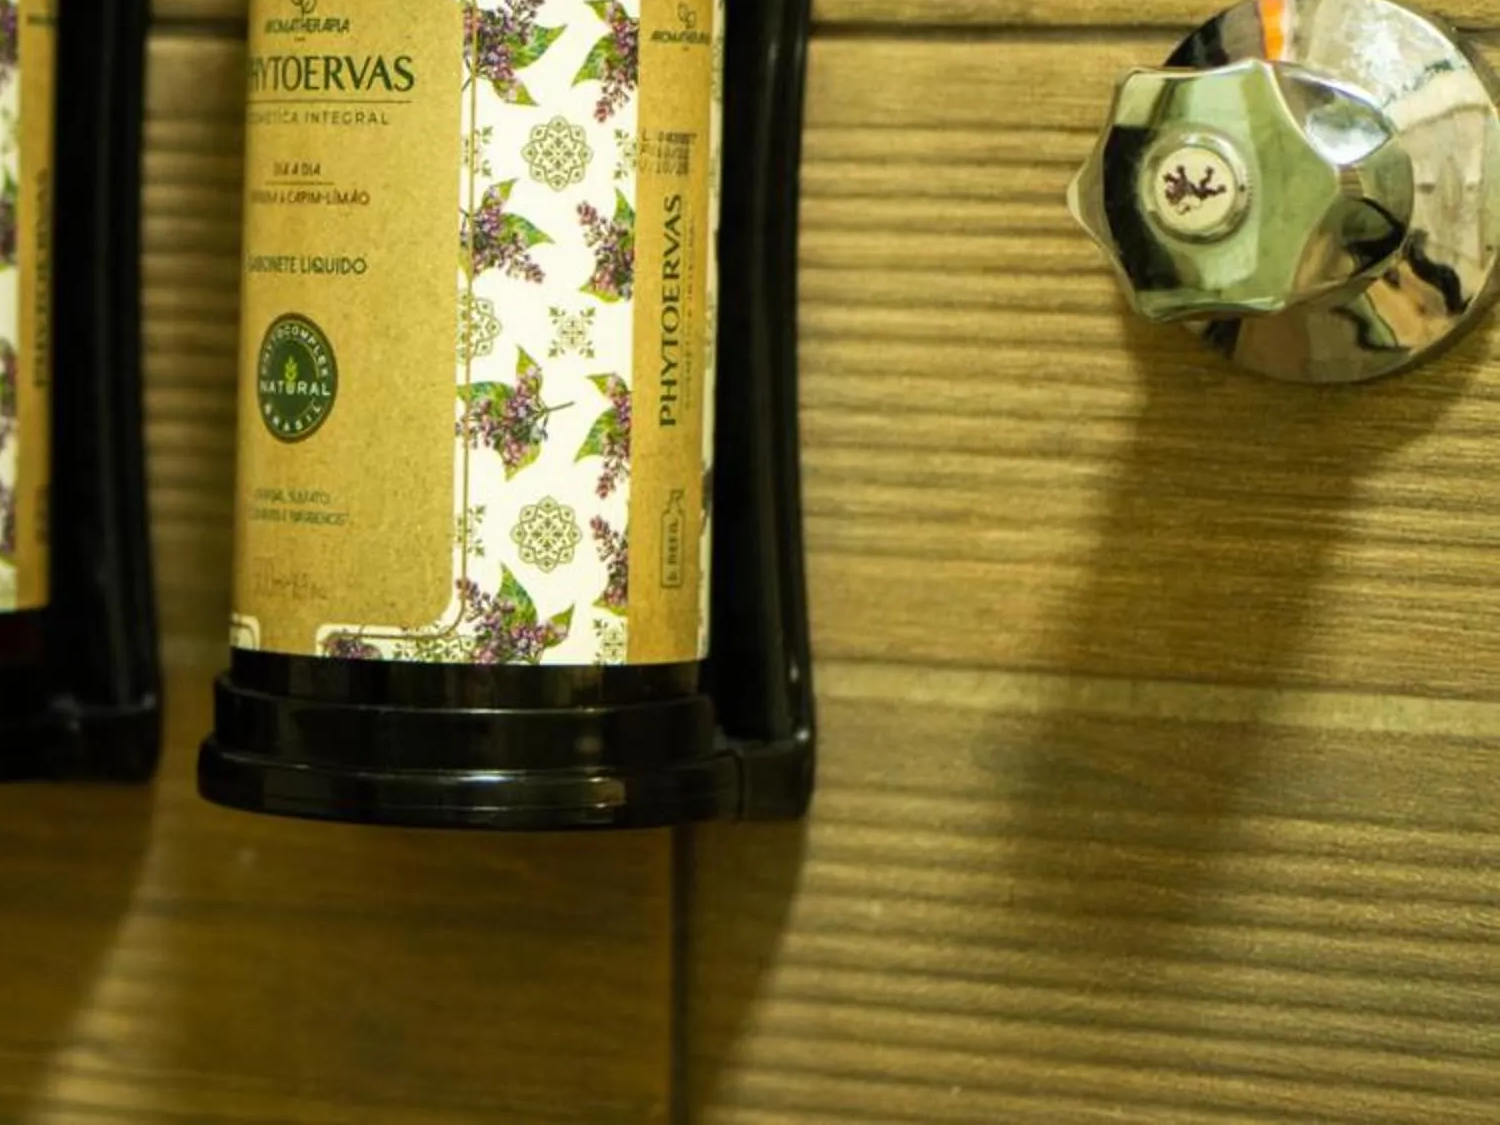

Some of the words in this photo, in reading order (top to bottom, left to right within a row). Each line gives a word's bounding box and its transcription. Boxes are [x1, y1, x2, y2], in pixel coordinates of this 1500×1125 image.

[248, 54, 416, 92] HYTOERVAS
[304, 111, 390, 126] INTEGRAL
[659, 193, 683, 428] PHYTOERVAS
[260, 379, 332, 398] NATURAL
[264, 398, 323, 432] BRASIL
